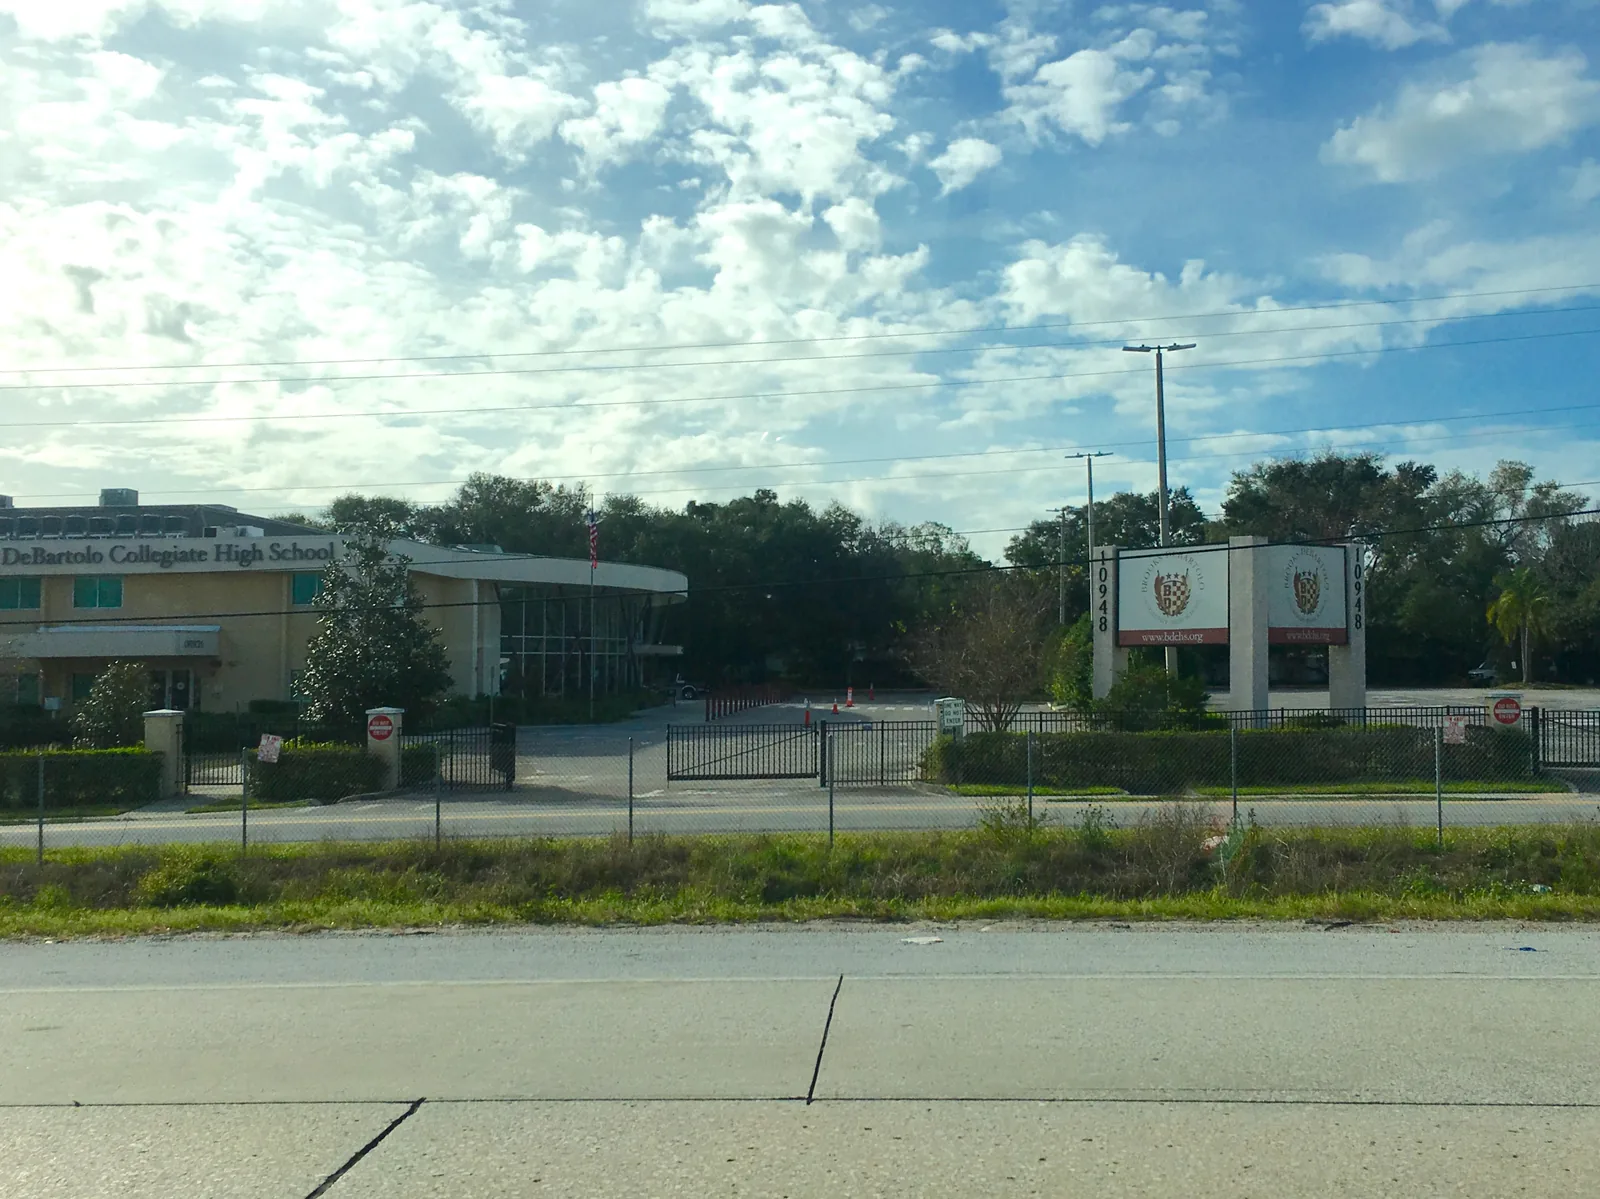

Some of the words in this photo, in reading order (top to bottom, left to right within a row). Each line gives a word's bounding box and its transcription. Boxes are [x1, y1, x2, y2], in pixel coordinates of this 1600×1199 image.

[2, 545, 104, 566] DeBartolo
[109, 544, 208, 569] Collegiate
[213, 542, 264, 567] High
[269, 542, 335, 561] School
[1098, 550, 1108, 632] 10948
[1354, 547, 1363, 630] 10948
[1142, 632, 1204, 643] www.bdchs.org
